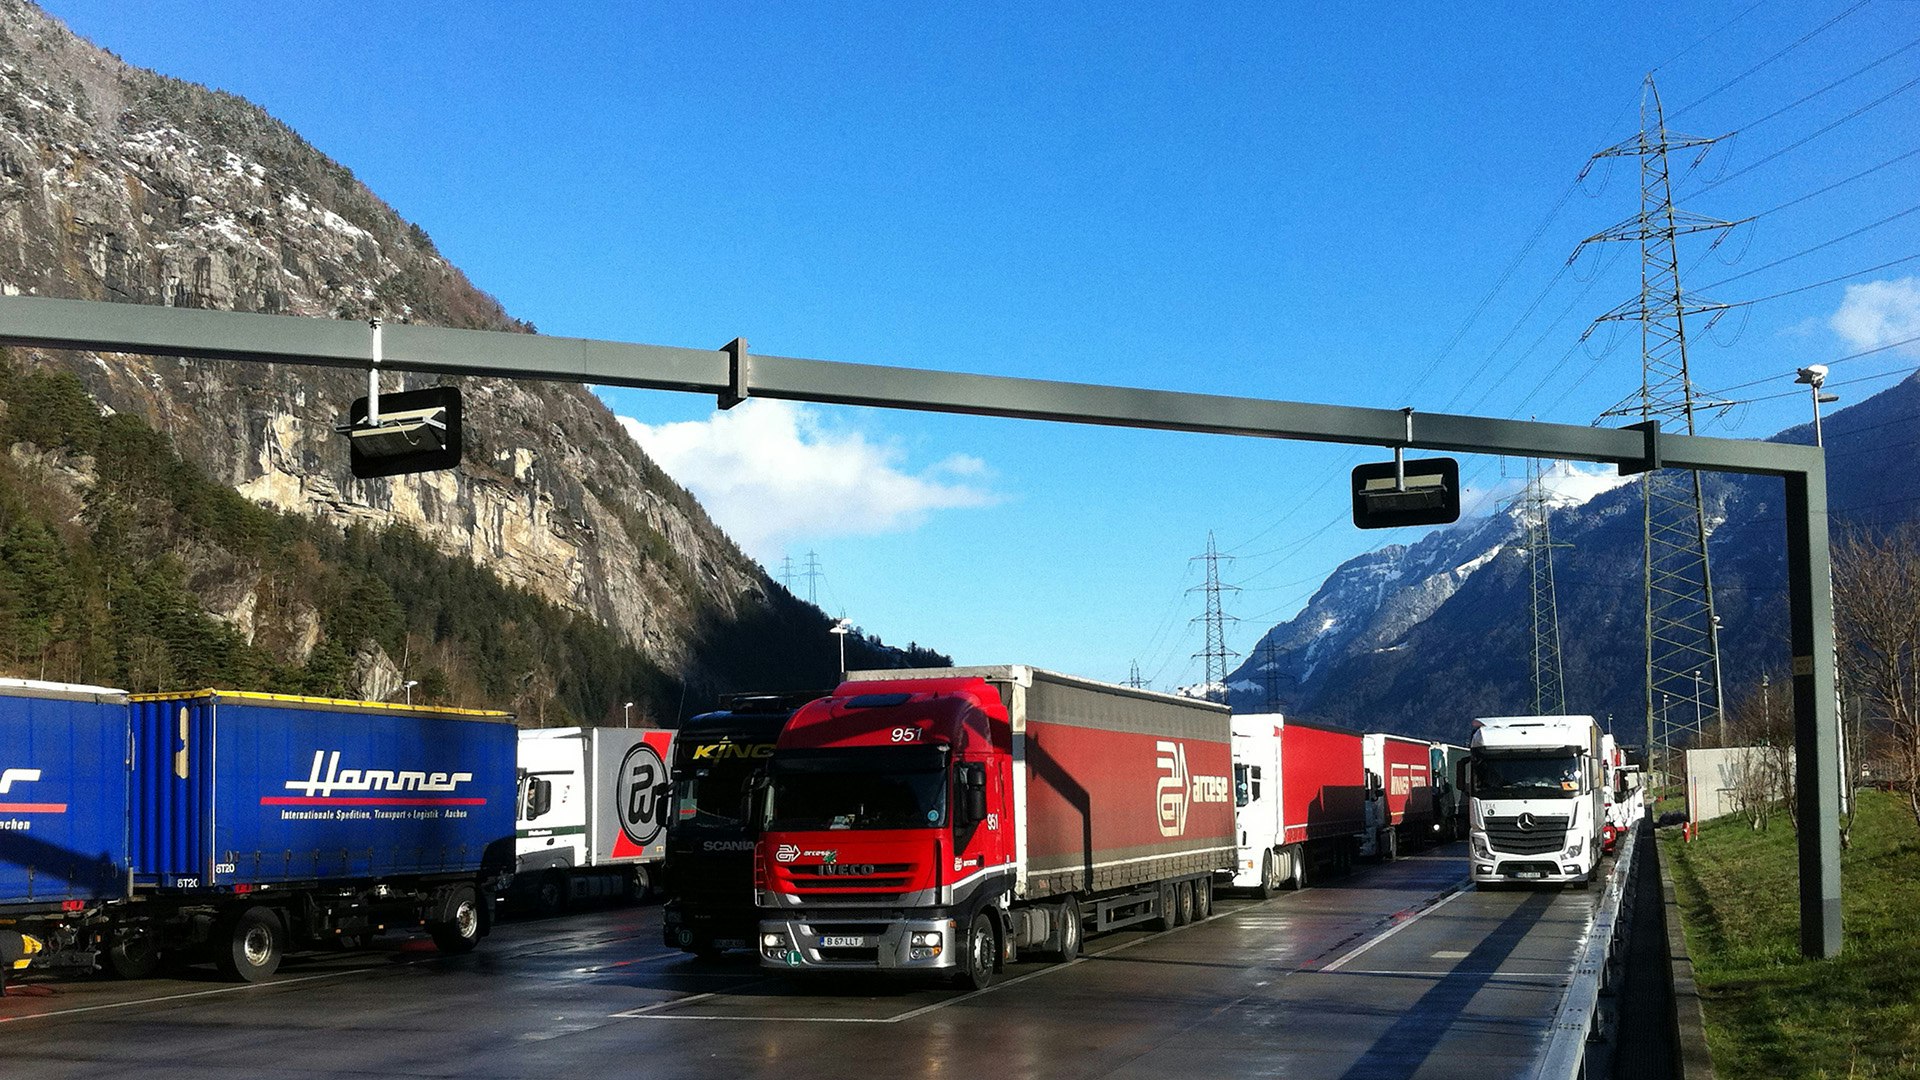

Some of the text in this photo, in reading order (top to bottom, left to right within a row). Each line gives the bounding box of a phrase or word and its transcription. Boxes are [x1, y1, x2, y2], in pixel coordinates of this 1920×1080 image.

[890, 728, 922, 742] 951
[285, 750, 472, 797] Hammer
[1193, 775, 1228, 803] arcese
[281, 809, 334, 820] Internationale
[336, 809, 372, 820] Spedition,
[374, 809, 407, 819] Transport
[413, 810, 438, 820] Logistik
[444, 810, 468, 818] Aachen
[987, 814, 998, 830] 951
[703, 840, 756, 852] SCANIA
[216, 863, 235, 874] 8T20
[818, 864, 875, 876] IVECO
